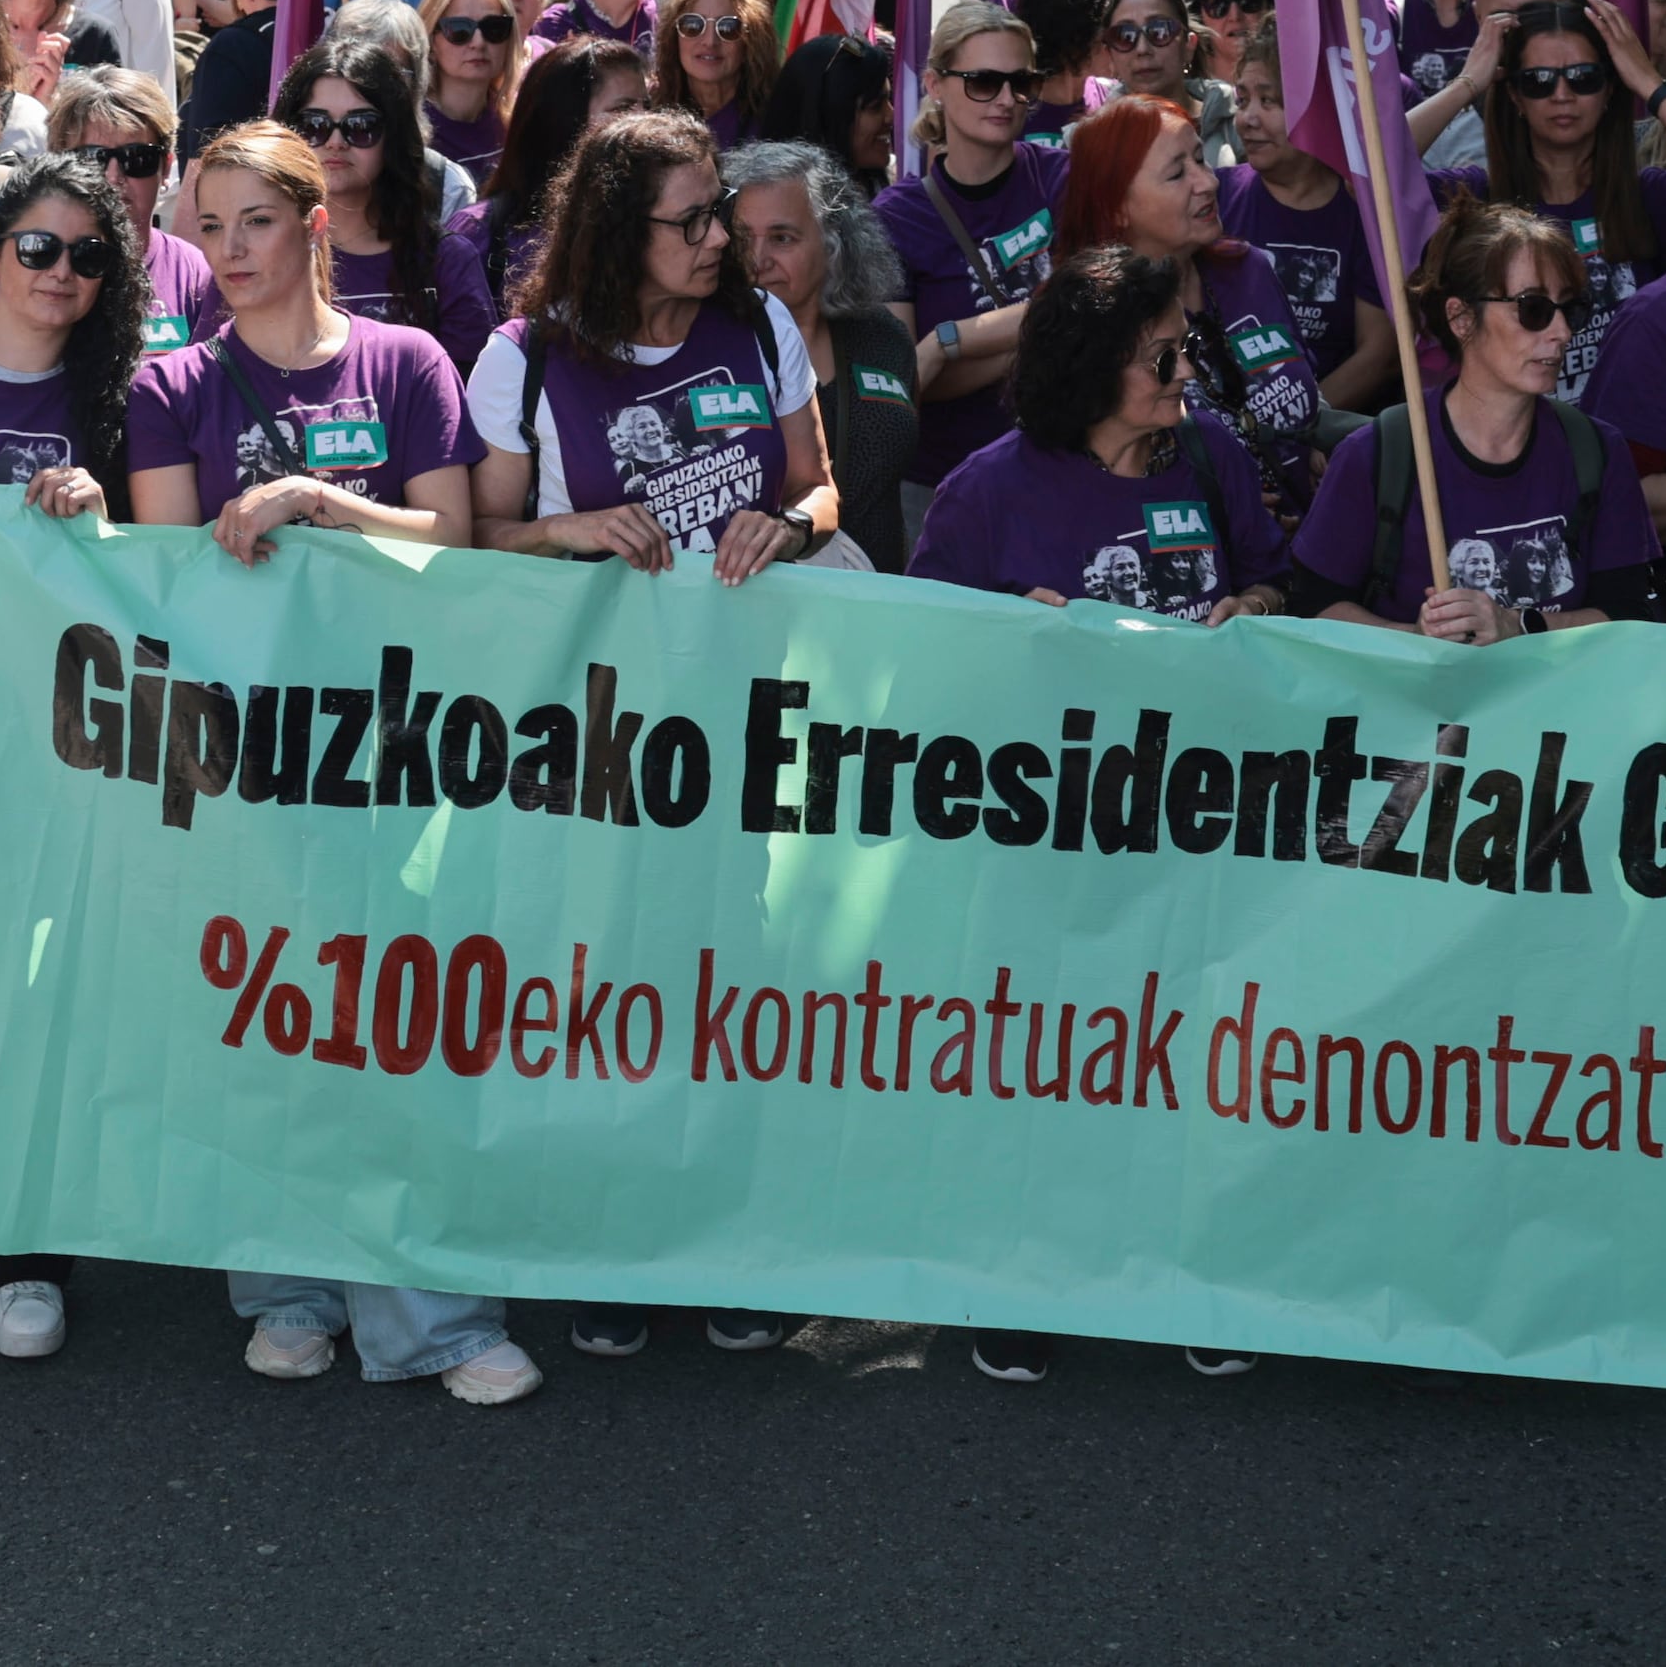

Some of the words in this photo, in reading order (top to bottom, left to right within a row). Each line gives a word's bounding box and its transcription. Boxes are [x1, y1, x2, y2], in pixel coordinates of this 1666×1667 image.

[1002, 220, 1048, 259] ELA
[143, 322, 182, 342] LA
[1237, 330, 1291, 360] ELA
[697, 391, 762, 417] ELA
[860, 371, 909, 402] ELA
[1246, 375, 1290, 412] KOAKO
[314, 429, 377, 456] ELA
[643, 455, 762, 515] RRESIDENTZIAK
[645, 444, 746, 498] GIPUZKOAKO
[656, 471, 764, 538] REBAN!
[1151, 508, 1208, 536] ELA
[53, 622, 711, 831] Gipuzkoako
[741, 676, 1594, 896] Erresidentziak
[199, 913, 663, 1080] %100eko
[694, 948, 1184, 1108] kontratuak
